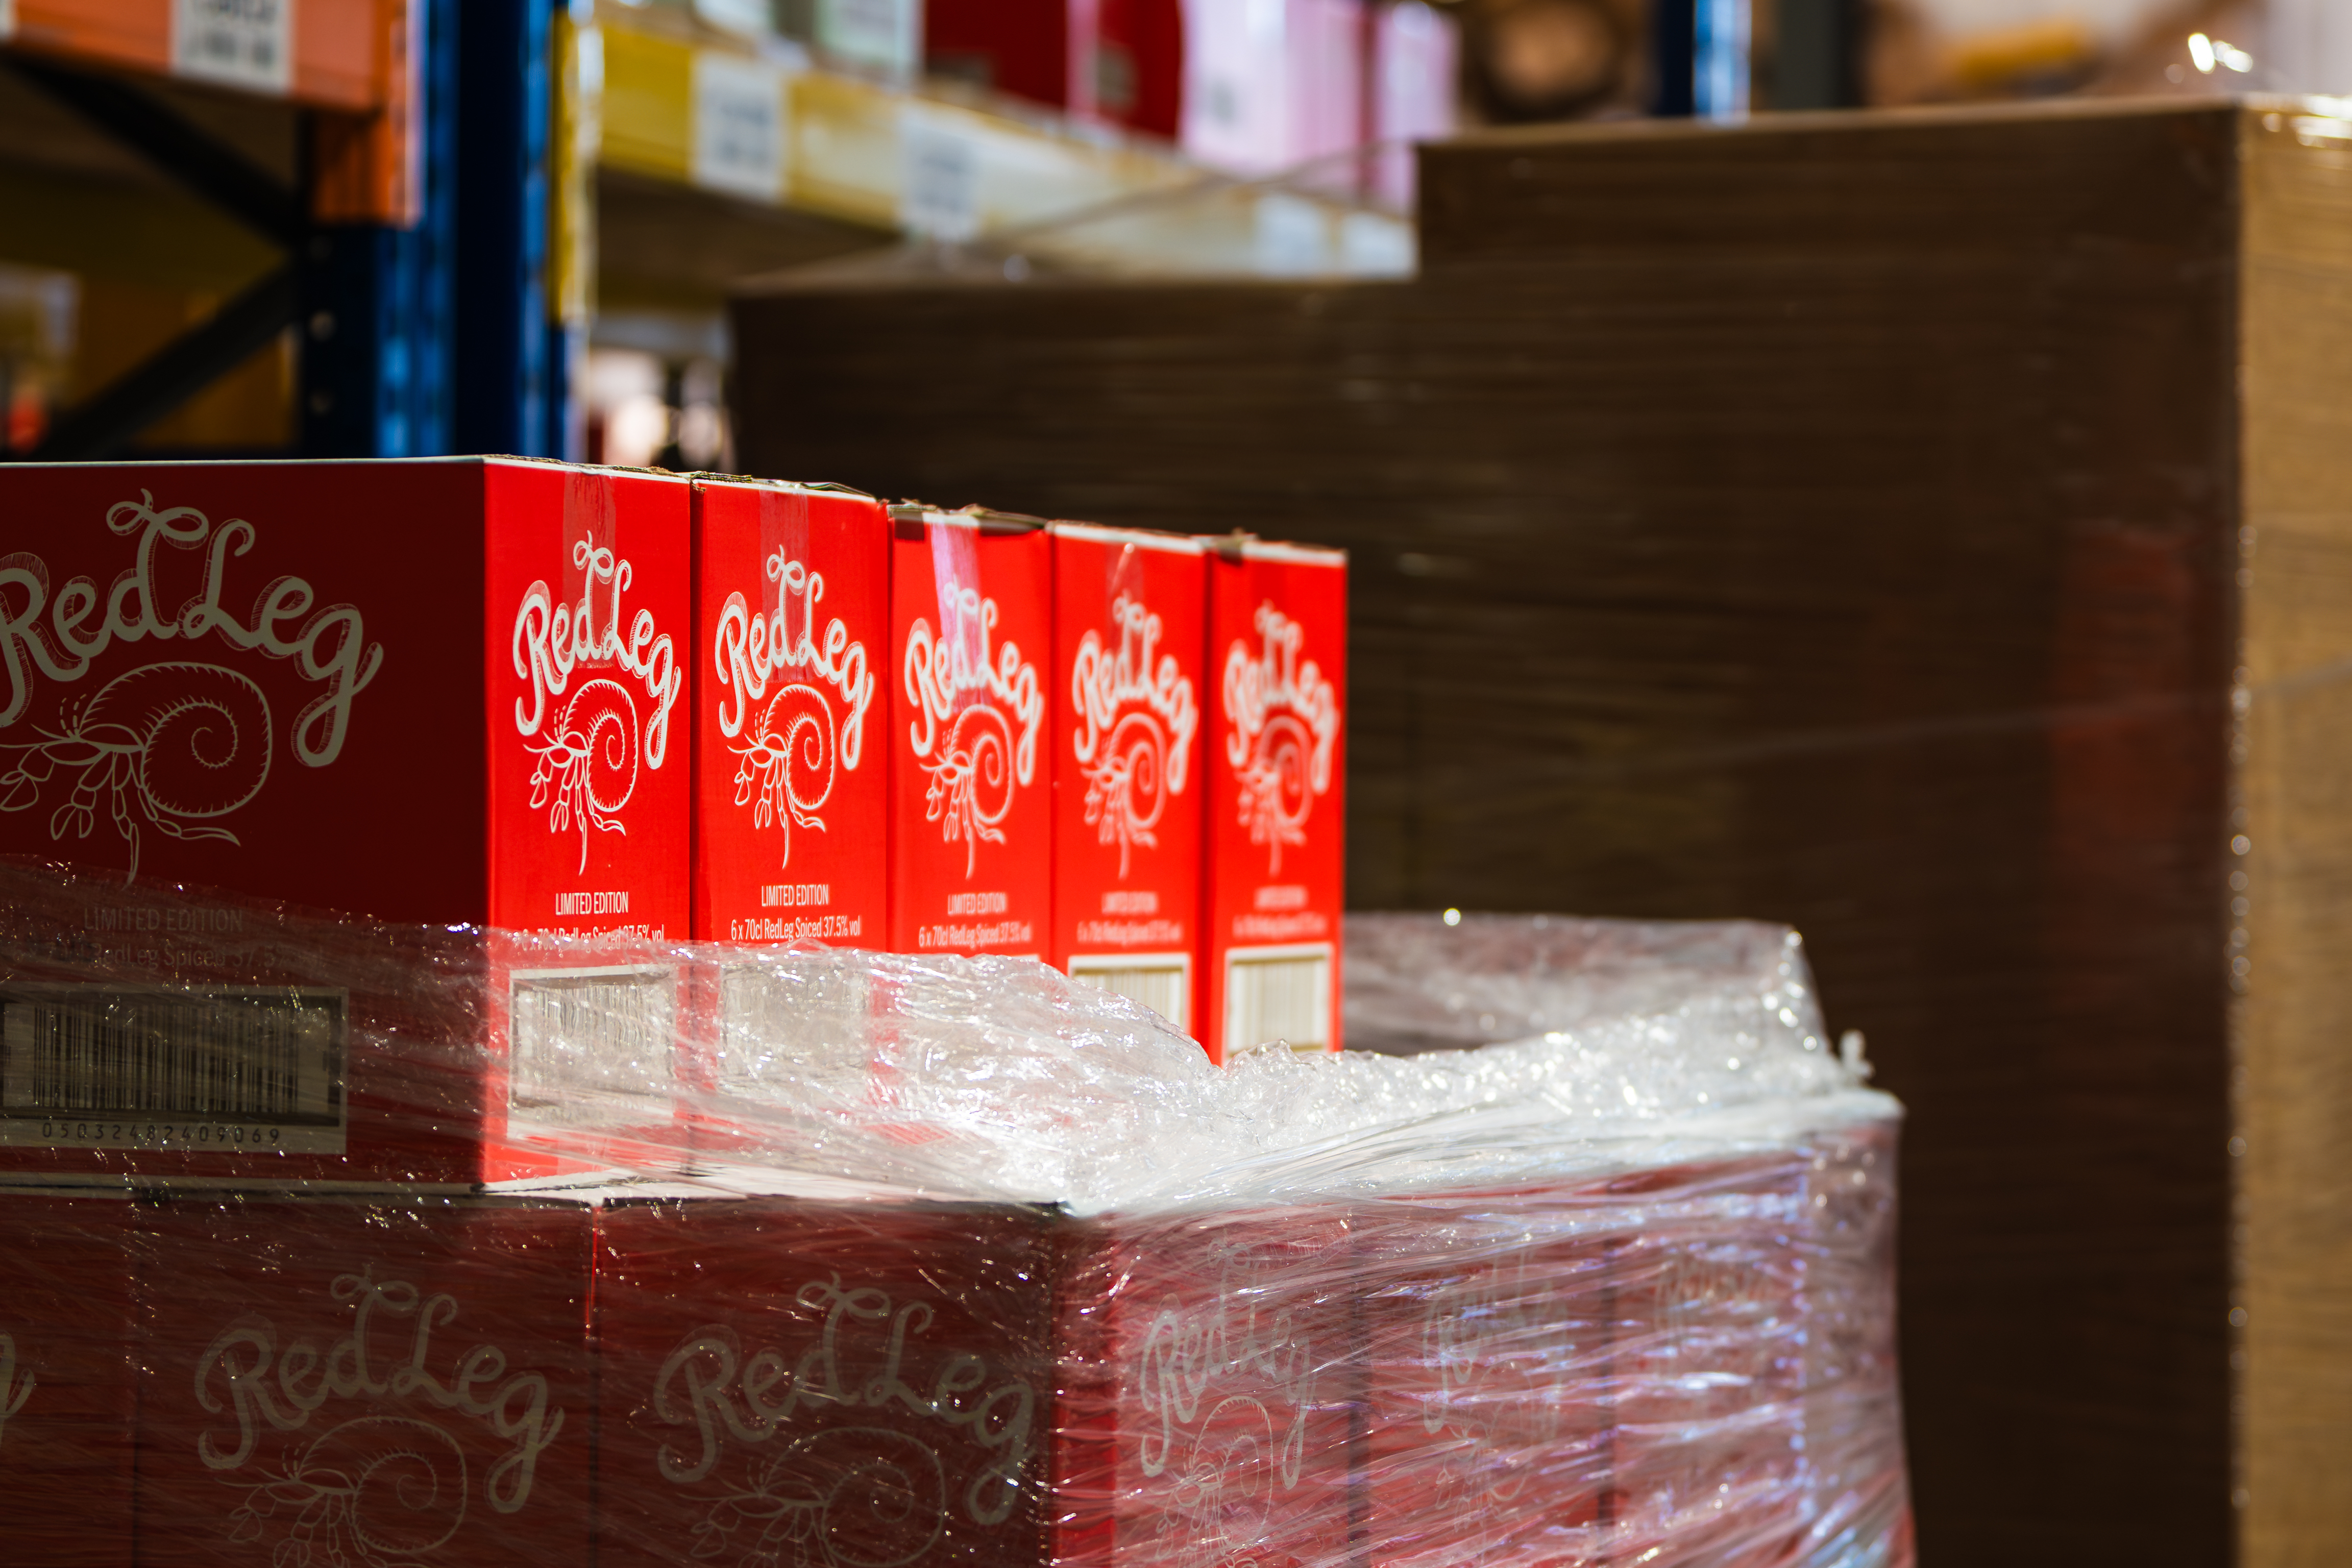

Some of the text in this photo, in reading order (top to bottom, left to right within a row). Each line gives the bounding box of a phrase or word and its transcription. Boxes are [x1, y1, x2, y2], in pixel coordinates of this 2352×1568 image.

[0, 488, 383, 767] RedLeg
[513, 530, 681, 769] RedLeg
[715, 544, 874, 770] RedLeg
[904, 574, 1043, 787] RedLeg
[1072, 588, 1198, 795] RedLeg
[84, 908, 243, 932] LIMITED EDITION
[556, 891, 628, 915] LIMITED EDITION
[731, 915, 861, 942] 6 x 70cl RedLeg Spiced 37.5% vol
[762, 884, 828, 906] LIMITED EDITION
[948, 892, 1007, 916] LIMITED EDITION
[194, 1264, 565, 1514] RedLeg
[653, 1271, 1037, 1525] RedLeg
